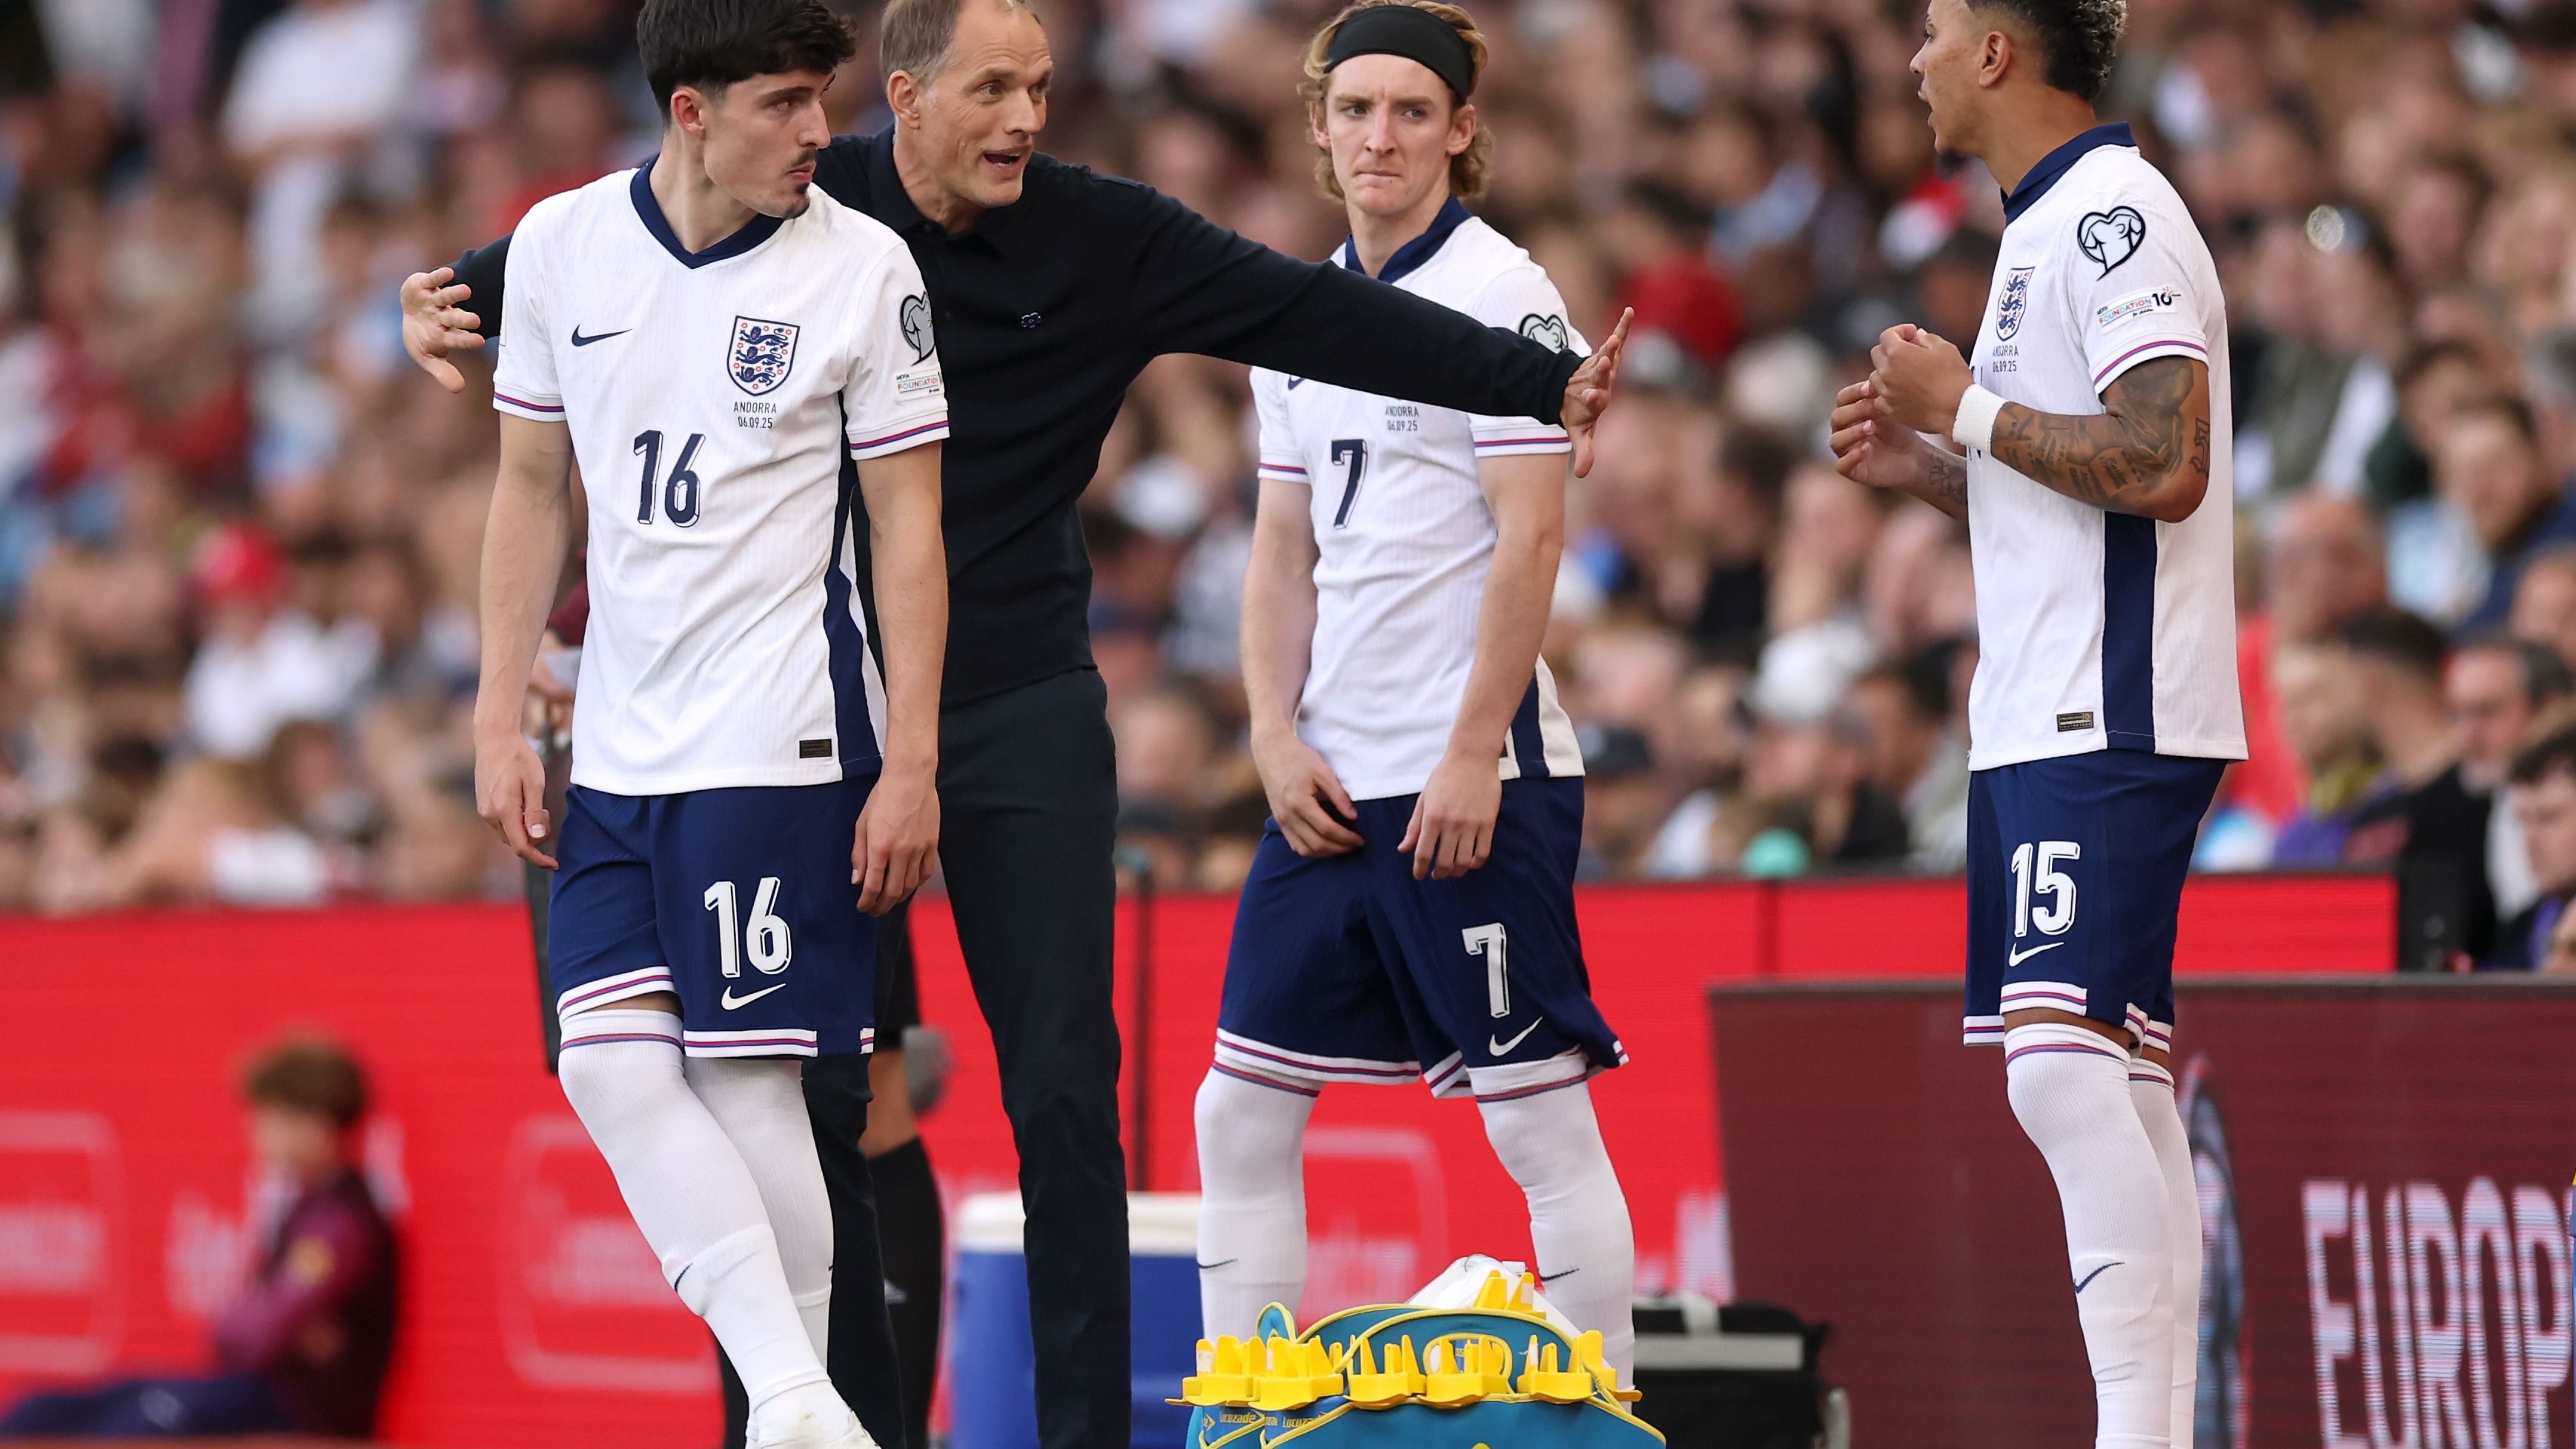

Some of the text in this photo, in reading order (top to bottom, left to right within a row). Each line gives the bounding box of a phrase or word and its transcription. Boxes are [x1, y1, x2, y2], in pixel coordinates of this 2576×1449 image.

[2099, 298, 2152, 325] FOUNDATION
[733, 401, 777, 414] ANDORRA
[738, 416, 772, 428] 06.09.25
[1385, 405, 1420, 417] ANDORRA
[1388, 420, 1418, 431] 06.09.25
[633, 429, 706, 528] 16
[1331, 439, 1368, 531] 7
[703, 876, 792, 978] 16
[2011, 840, 2081, 938] 15
[1461, 922, 1510, 1018] 7
[2302, 1175, 2576, 1449] EUROP
